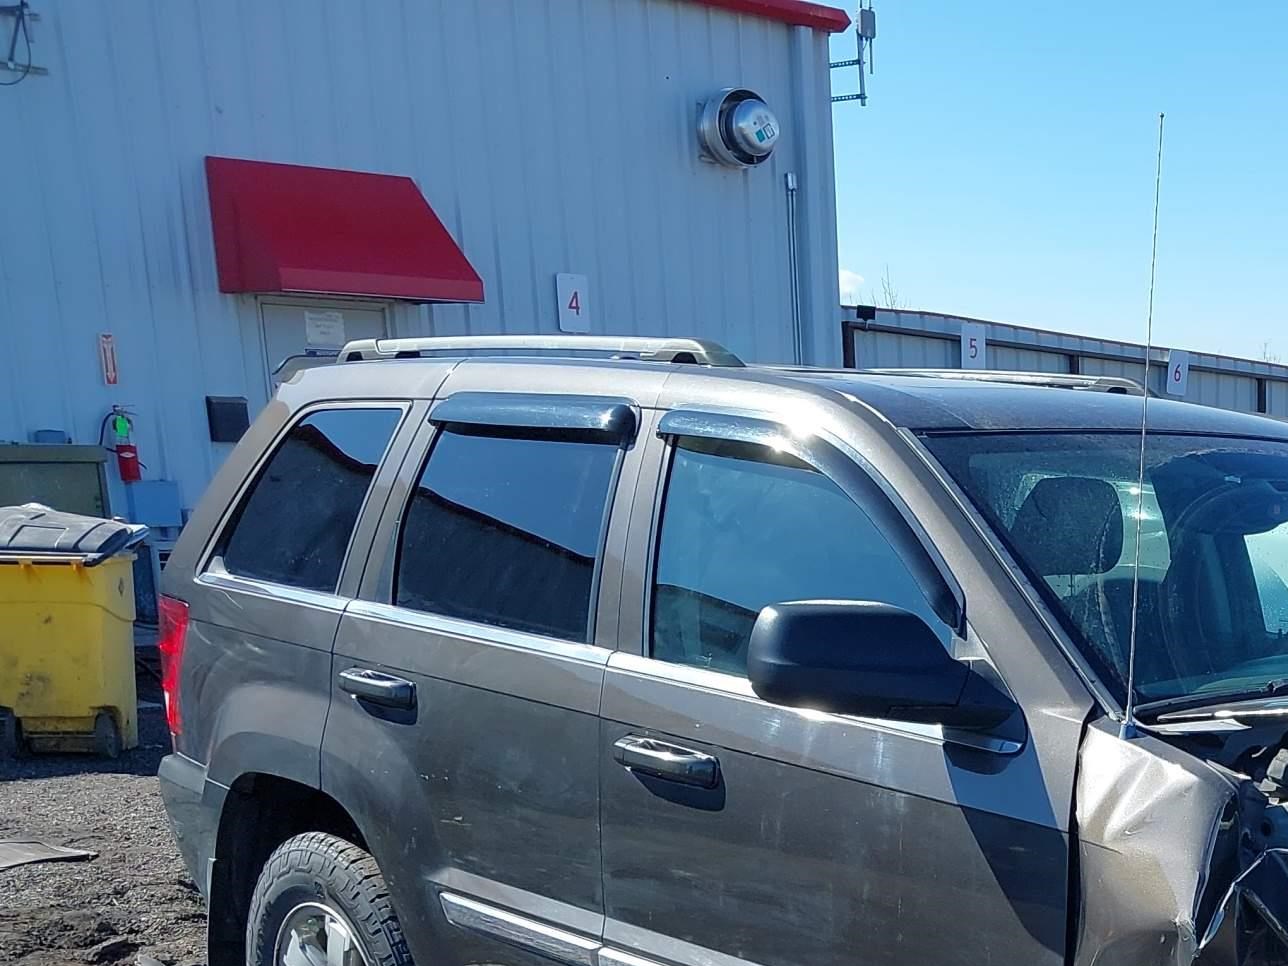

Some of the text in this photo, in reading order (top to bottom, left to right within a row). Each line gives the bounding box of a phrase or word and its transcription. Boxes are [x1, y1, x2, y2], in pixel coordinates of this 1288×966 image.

[567, 290, 581, 317] 4
[969, 337, 979, 359] 5
[1173, 363, 1182, 382] 6
